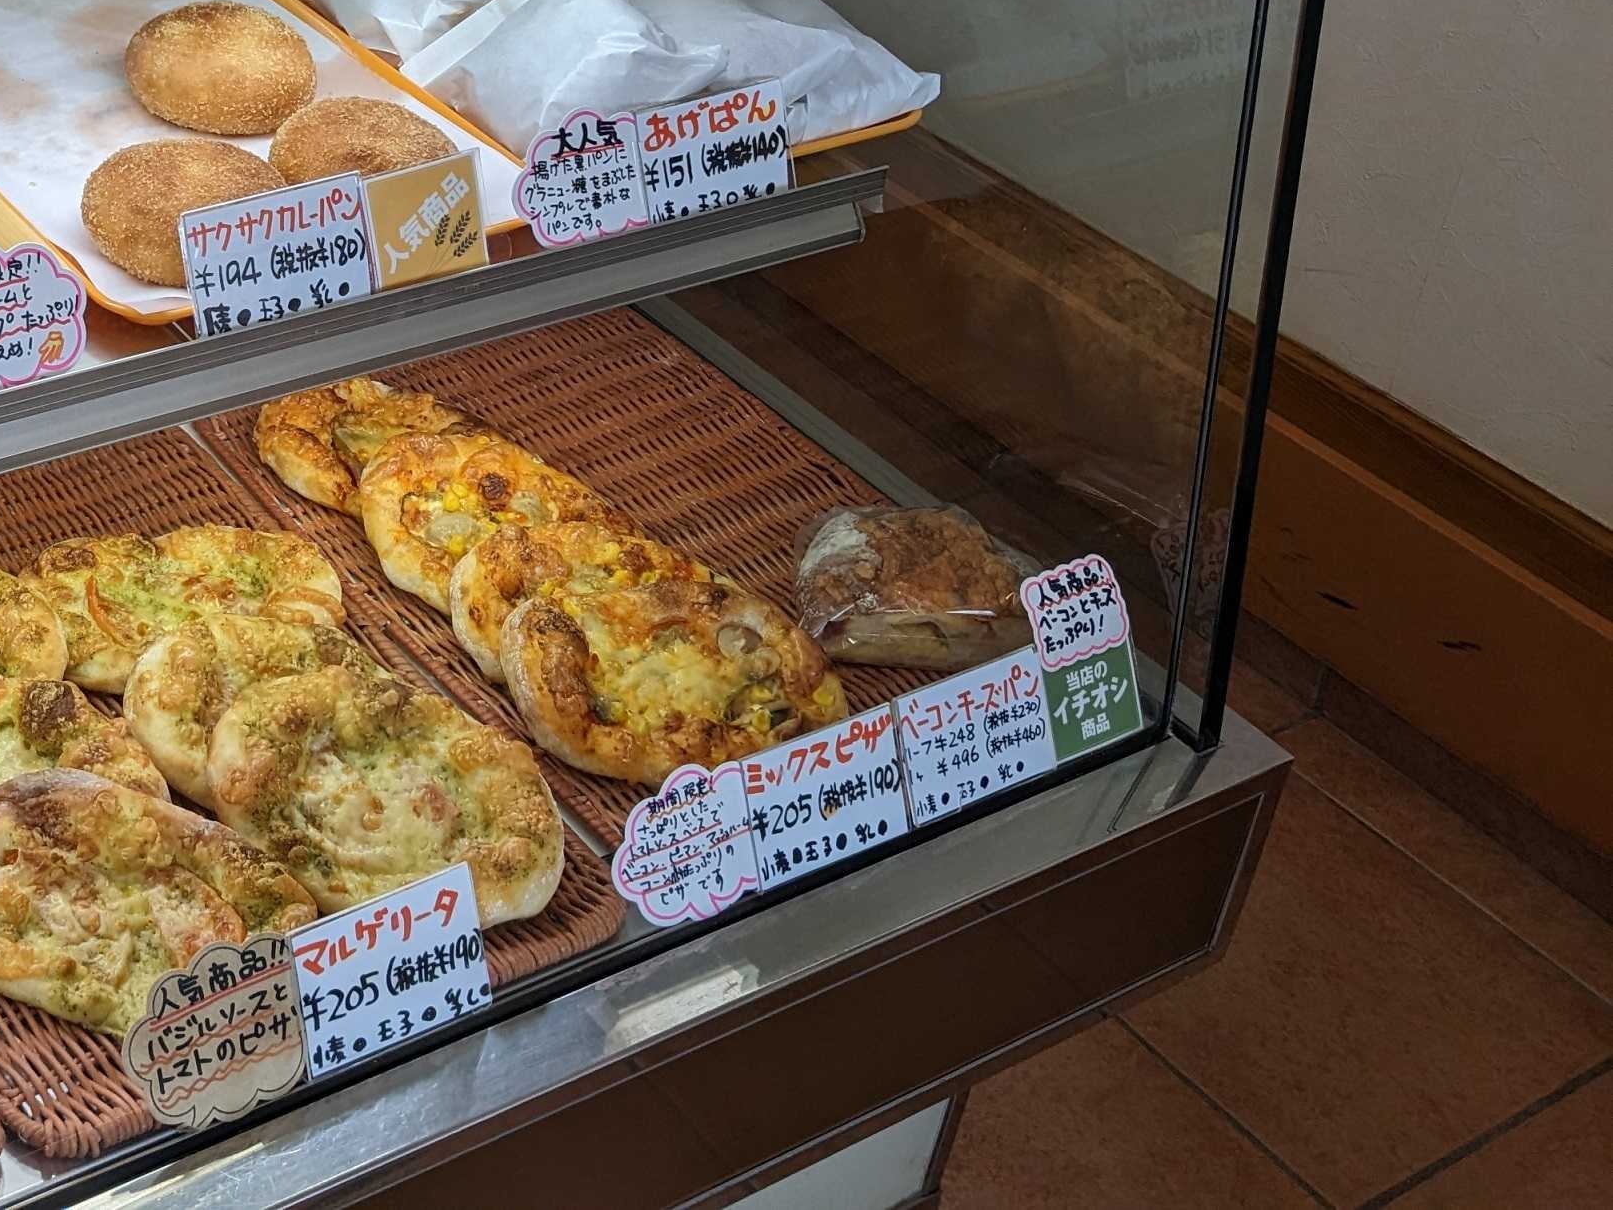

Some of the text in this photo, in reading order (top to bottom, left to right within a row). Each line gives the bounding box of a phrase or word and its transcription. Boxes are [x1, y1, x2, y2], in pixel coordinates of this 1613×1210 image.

[551, 119, 623, 159] 大人気
[644, 90, 775, 152] あげぱん
[645, 151, 693, 191] ¥151
[188, 188, 360, 257] サクサクカレーパン
[383, 171, 470, 274] 人気商品
[547, 213, 602, 235] パンです。
[194, 256, 261, 297] ¥194
[1066, 660, 1108, 692] 当店の
[901, 664, 1038, 739] ベーコンチーズパン
[1053, 678, 1128, 725] イチオシ
[935, 723, 975, 751] ¥248
[1081, 713, 1111, 740] 商品
[747, 714, 891, 794] ミックスピザ
[937, 745, 979, 776] ¥496
[753, 794, 812, 840] ¥205
[294, 888, 458, 975] マルゲリータ
[149, 983, 287, 1061] バジルソースと
[303, 971, 379, 1031] ¥205
[157, 1005, 297, 1094] トマトのピザ
